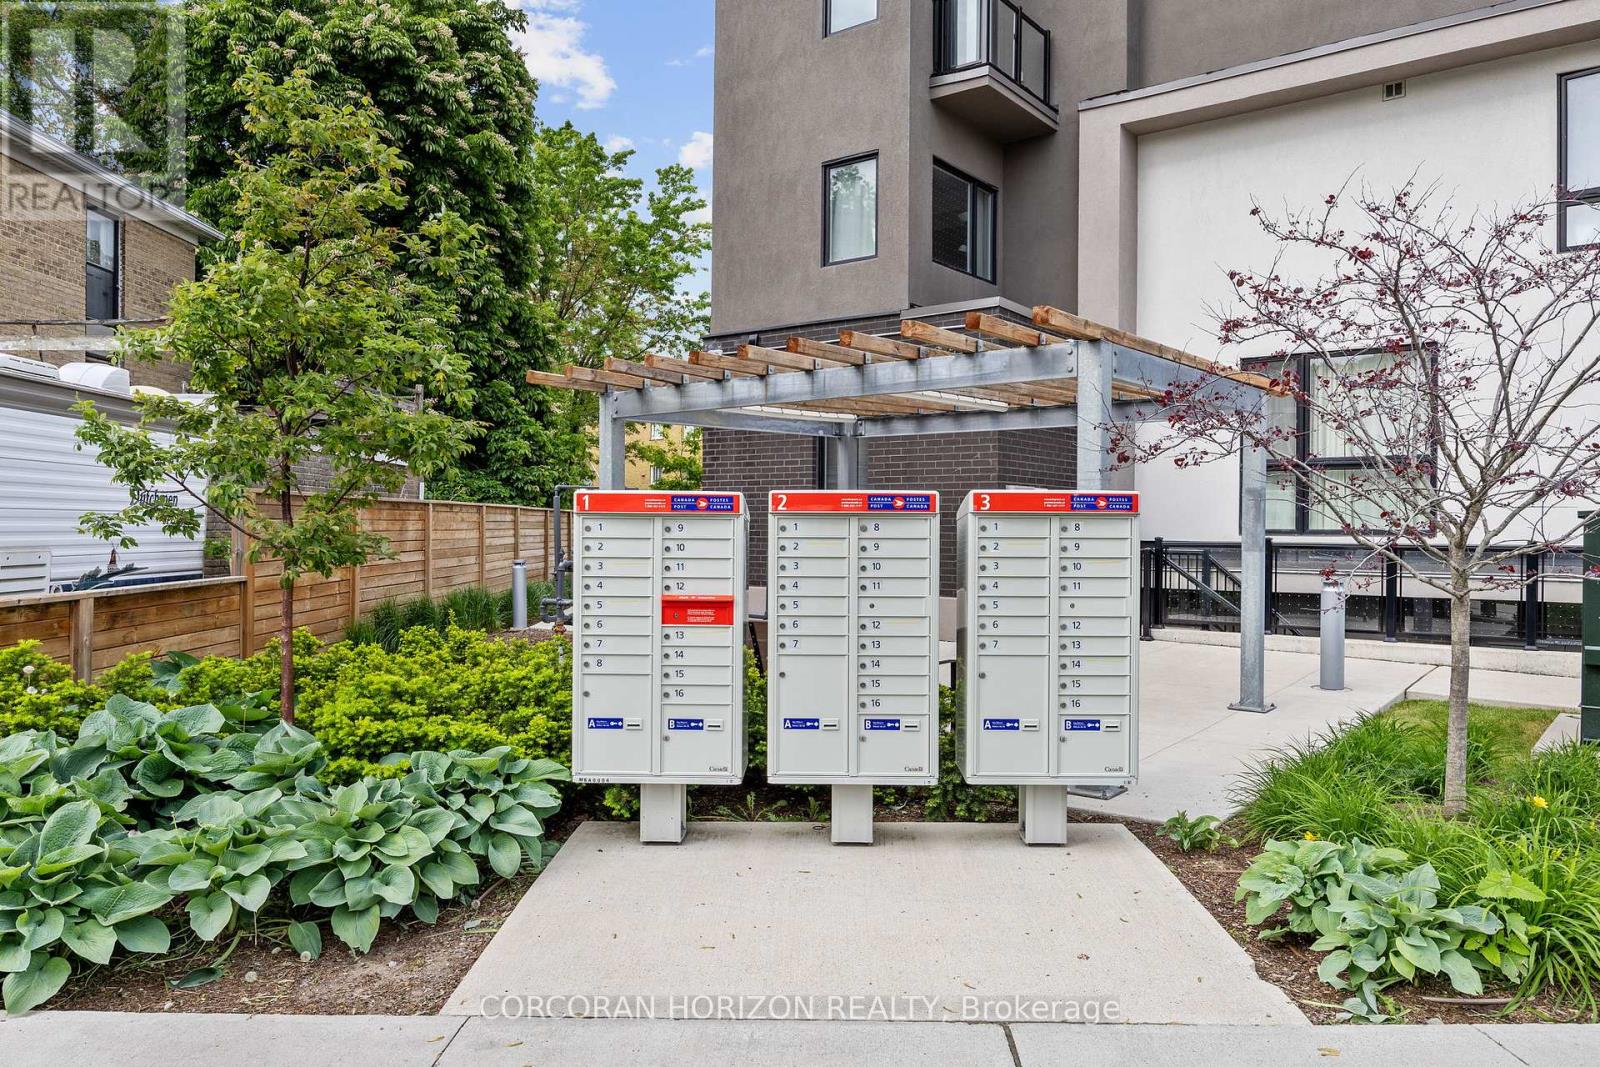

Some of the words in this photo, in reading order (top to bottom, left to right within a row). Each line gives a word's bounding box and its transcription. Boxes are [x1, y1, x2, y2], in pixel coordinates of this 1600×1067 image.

[582, 494, 590, 511] 1
[777, 494, 788, 511] 2
[980, 494, 991, 511] 3
[677, 524, 684, 532] 9
[873, 523, 880, 531] 8
[1074, 523, 1081, 531] 8
[597, 542, 603, 550] 2
[676, 543, 685, 551] 10
[793, 542, 799, 550] 2
[873, 543, 880, 551] 9
[993, 542, 999, 550] 2
[1074, 543, 1080, 551] 9
[598, 562, 603, 570] 3
[676, 563, 684, 571] 11
[793, 562, 799, 570] 3
[872, 563, 881, 571] 10
[993, 562, 999, 570] 3
[1073, 562, 1081, 570] 10
[597, 581, 603, 589] 4
[676, 582, 684, 590] 12
[792, 581, 798, 589] 4
[872, 582, 880, 590] 11
[992, 581, 998, 589] 4
[1073, 582, 1080, 590] 11
[597, 601, 602, 609] 5
[793, 601, 798, 609] 5
[993, 601, 998, 609] 5
[597, 620, 603, 628] 6
[793, 620, 798, 628] 6
[871, 621, 880, 629] 12
[993, 620, 998, 628] 6
[1072, 621, 1081, 629] 12
[675, 631, 684, 639] 13
[597, 640, 603, 648] 7
[871, 641, 880, 649] 13
[992, 640, 998, 648] 7
[1072, 641, 1080, 649] 13
[675, 650, 684, 658] 14
[596, 659, 602, 667] 8
[871, 660, 880, 668] 14
[1072, 660, 1080, 669] 14
[675, 670, 684, 678] 15
[871, 680, 880, 688] 15
[1072, 680, 1080, 688] 15
[675, 689, 684, 697] 16
[871, 699, 880, 707] 16
[1071, 699, 1080, 707] 16
[589, 719, 596, 728] A
[669, 720, 675, 728] B
[785, 720, 792, 728] A
[865, 720, 871, 729] B
[984, 721, 991, 729] A
[1066, 721, 1072, 729] B
